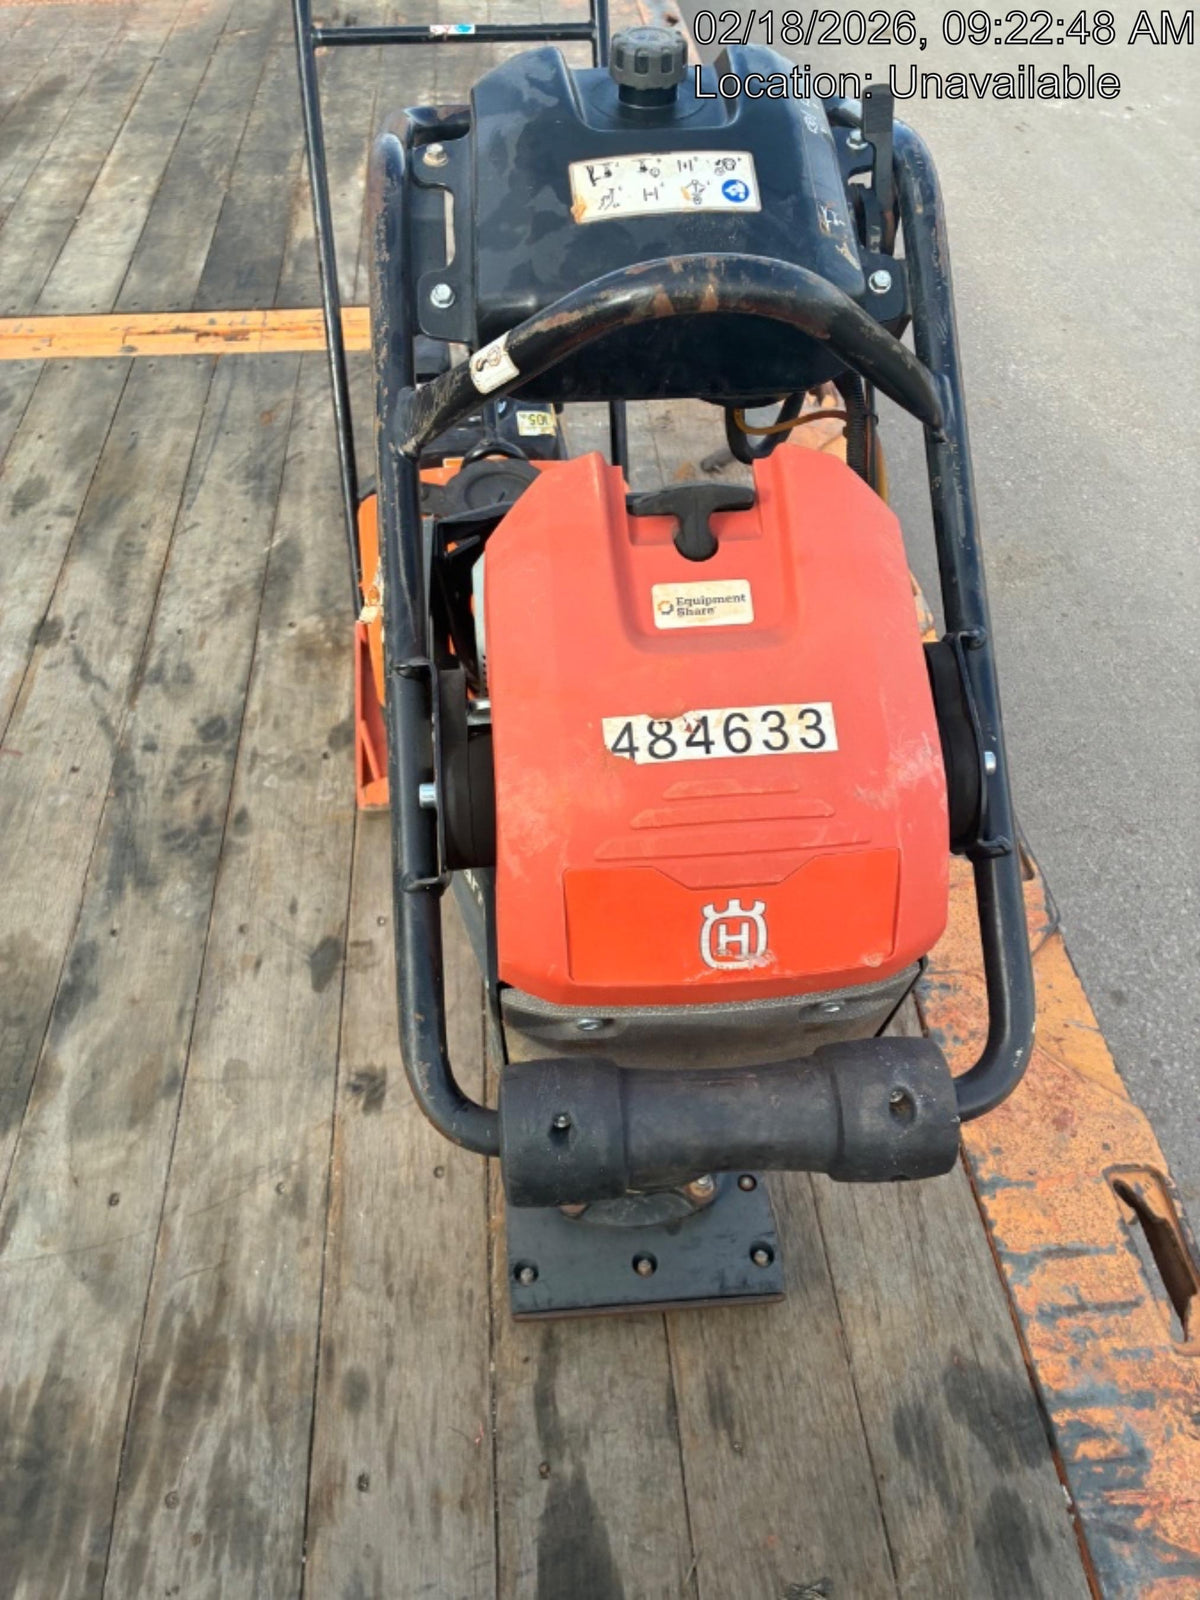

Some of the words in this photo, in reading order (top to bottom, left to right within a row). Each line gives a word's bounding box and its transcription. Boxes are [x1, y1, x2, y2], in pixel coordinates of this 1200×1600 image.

[676, 594, 746, 607] Equipment
[676, 606, 715, 617] Share
[611, 708, 826, 760] 484633
